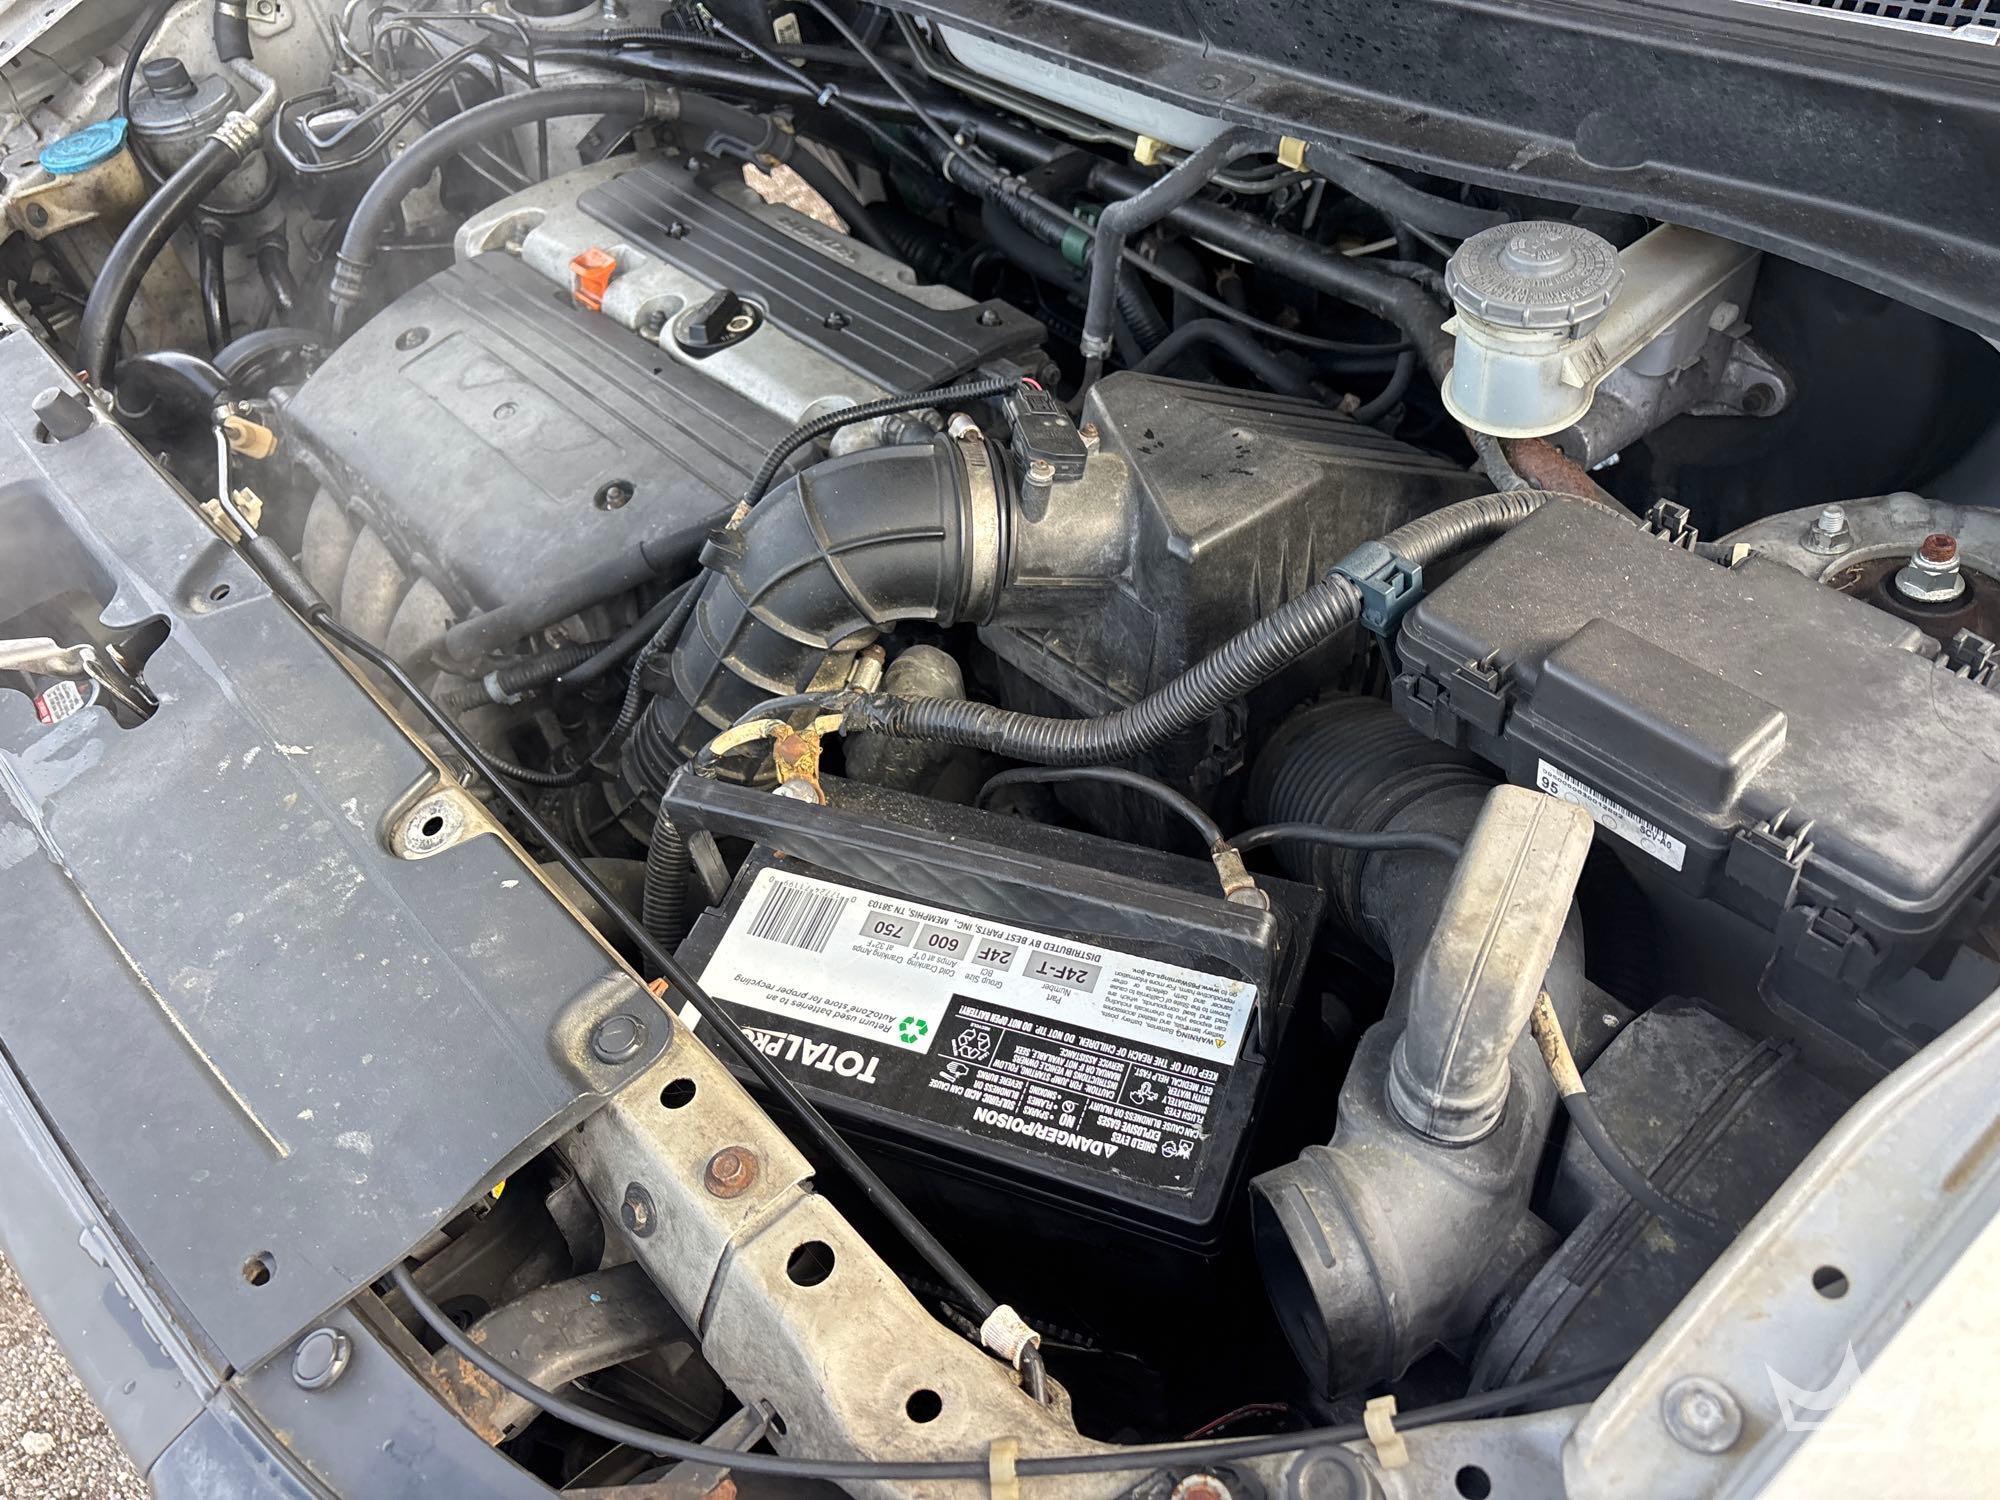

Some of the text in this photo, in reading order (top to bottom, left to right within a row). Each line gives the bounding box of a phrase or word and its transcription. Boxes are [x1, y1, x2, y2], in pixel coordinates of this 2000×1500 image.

[1541, 775, 1559, 795] 95
[866, 899, 1101, 962] DISTRIBUTED BY BEST PARTS, INC., MEMPHIS, TN 38103
[872, 920, 906, 938] 750
[927, 933, 959, 951] 600
[850, 944, 904, 963] Cranking Amps
[976, 945, 1011, 964] 24F
[905, 957, 955, 977] Cold Cranking
[935, 956, 957, 967] Amps
[979, 967, 994, 976] BCI
[1035, 960, 1088, 983] 24F-T
[1113, 971, 1148, 983] information
[732, 973, 776, 990] recycling
[963, 973, 1003, 988] Group Size
[1109, 983, 1128, 991] cause
[1111, 977, 1128, 985] other
[776, 984, 808, 998] proper
[1040, 982, 1071, 996] Number
[1135, 990, 1165, 1002] California
[1144, 985, 1168, 995] defects
[1172, 992, 1188, 1000] birth
[778, 996, 789, 1004] to
[807, 994, 822, 1003] for
[823, 998, 848, 1009] store
[1044, 993, 1062, 1004] Part
[1104, 996, 1132, 1008] including
[1119, 994, 1138, 1002] which
[1172, 1000, 1189, 1008] State
[1195, 990, 1235, 1004] reproductive
[789, 999, 832, 1016] batteries
[1133, 1004, 1164, 1016] chemicals
[1182, 1009, 1196, 1017] lead
[1210, 1001, 1232, 1010] cancer
[832, 1011, 857, 1023] used
[1120, 1015, 1142, 1026] battery
[1209, 1009, 1230, 1018] known
[1214, 1017, 1228, 1025] lead
[856, 1017, 891, 1032] Return
[1188, 1017, 1212, 1027] expose
[957, 1004, 1219, 1081] KEEP OUT OF THE REACH OF CHILDREN. DO NOT TIP. DO NOT OPEN BATTERY!
[1013, 1045, 1122, 1080] MANUAL OR IF NOT AVAILABLE, SEEK
[1057, 1047, 1124, 1072] SERVICE ASSISTANCE.
[975, 1069, 1023, 1089] SEVERE BURNS
[992, 1058, 1115, 1099] CAUTION: FOR JUMP STARTING, FOLLOW
[1011, 1053, 1119, 1090] INSTRUCTIONS IN VEHICLE OWNERS
[1131, 1066, 1213, 1095] GET MEDICAL HELP FAST.
[927, 1078, 1016, 1110] SULFURIC ACID CAN CAUSE
[972, 1079, 1019, 1099] BLINDNESS OR
[1027, 1084, 1057, 1099] SMOKING
[1164, 1085, 1210, 1104] WITH WATER.
[1025, 1095, 1053, 1109] FLAMES
[1161, 1094, 1207, 1114] IMMEDIATELY
[1021, 1105, 1050, 1120] SPARKS
[1057, 1112, 1076, 1128] NO
[1088, 1100, 1199, 1139] CAN CAUSE BLINDNESS OR INJURY
[1163, 1105, 1204, 1124] FLUSH EYES
[971, 1106, 1104, 1155] DANGER/POISON
[1095, 1114, 1161, 1141] EXPLOSIVE GASES
[1109, 1131, 1157, 1153] SHIELD EYES
